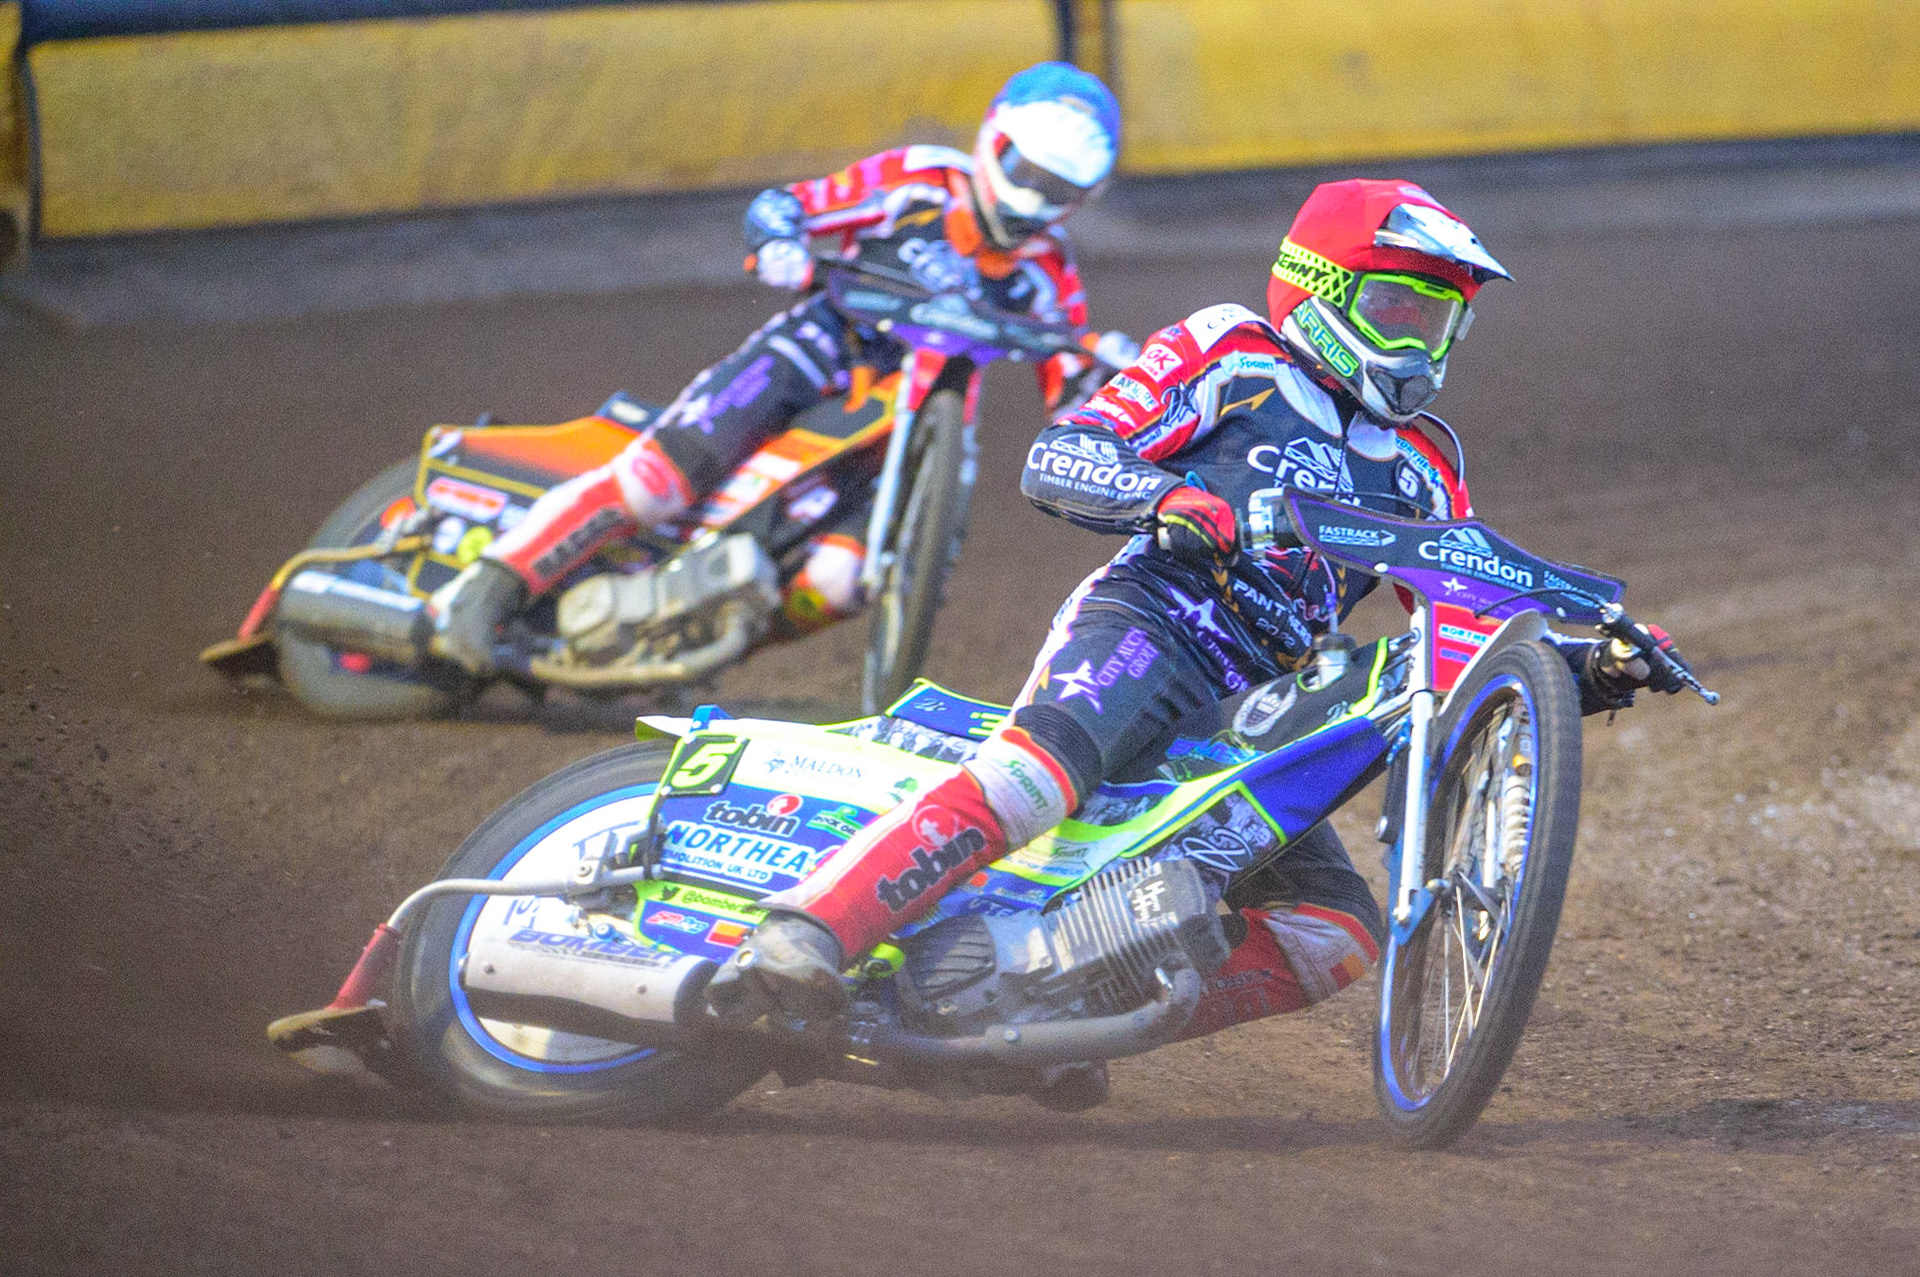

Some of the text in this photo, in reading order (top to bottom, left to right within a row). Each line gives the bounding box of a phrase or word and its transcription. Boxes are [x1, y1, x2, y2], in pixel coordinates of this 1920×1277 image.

[1278, 253, 1331, 283] ENNY
[1027, 442, 1162, 492] Crendon
[1039, 473, 1073, 490] TIMBER
[1398, 466, 1419, 498] 5
[1318, 525, 1380, 540] FASTRACK
[1418, 541, 1533, 588] Crendon
[1097, 656, 1126, 687] CITY
[670, 741, 739, 789] 5
[790, 754, 867, 779] MALDON
[705, 801, 799, 837] tobin
[663, 849, 769, 881] EMOLITION UK LTD
[877, 826, 987, 913] tobin
